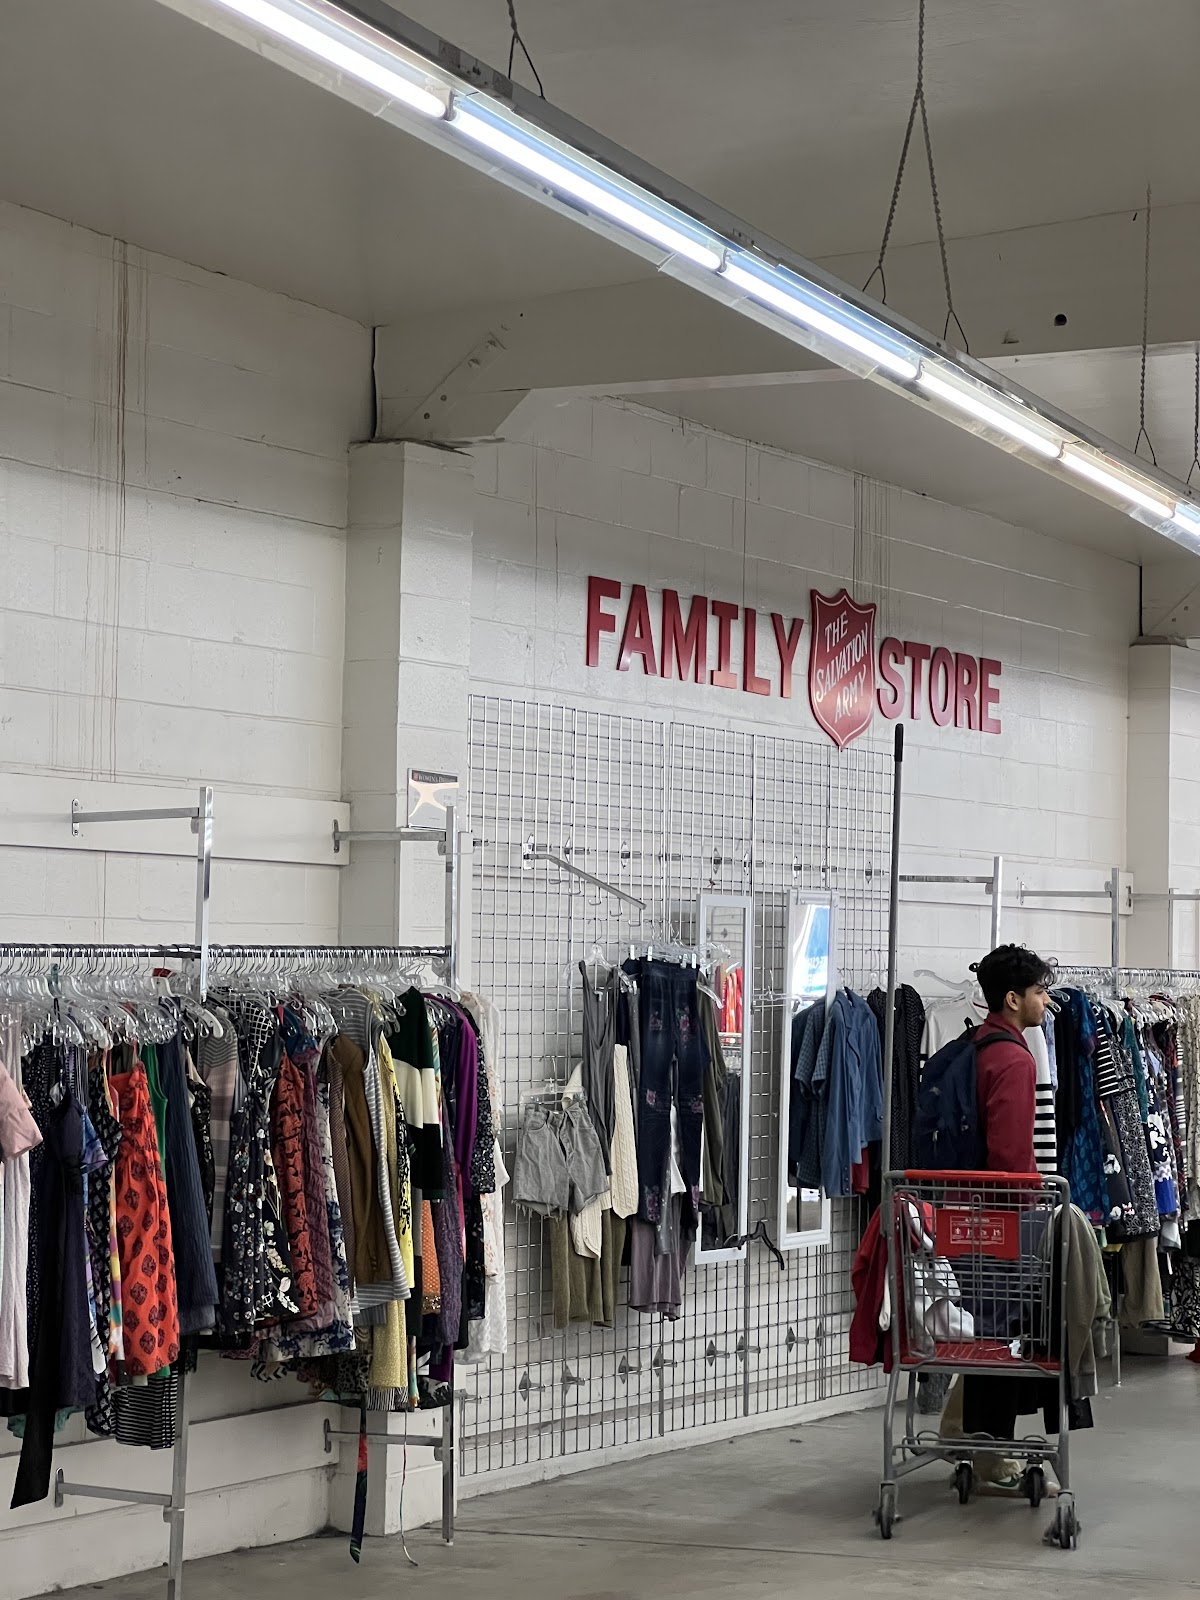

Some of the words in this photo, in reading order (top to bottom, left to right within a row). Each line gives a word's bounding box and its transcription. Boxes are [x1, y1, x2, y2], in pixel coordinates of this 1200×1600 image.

[586, 575, 804, 698] FAMILY
[877, 637, 1001, 734] STORE
[815, 622, 868, 703] SALVATION
[824, 610, 848, 652] THE
[834, 664, 867, 724] ARMY
